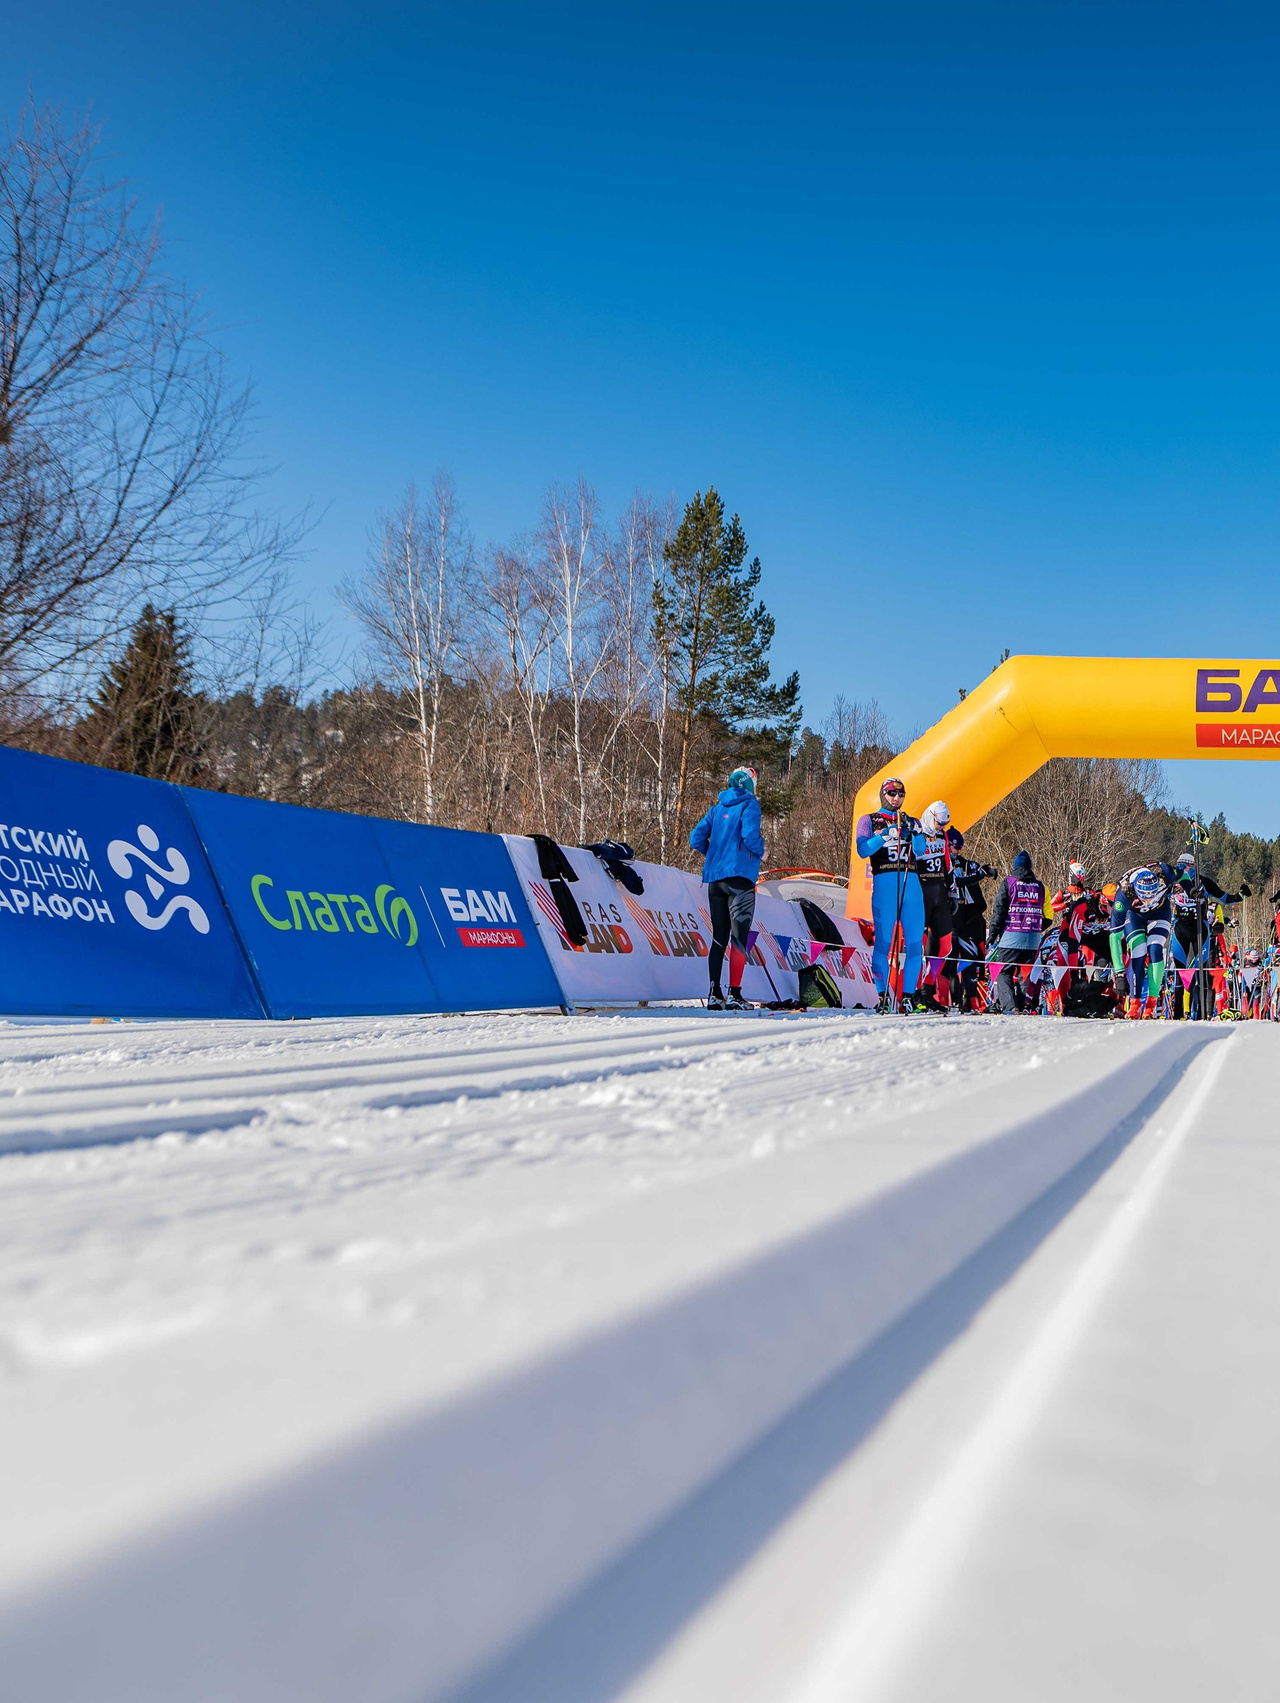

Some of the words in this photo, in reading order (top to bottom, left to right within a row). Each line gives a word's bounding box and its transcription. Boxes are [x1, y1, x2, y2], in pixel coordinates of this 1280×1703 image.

[0, 823, 90, 862] ТСКИЙ
[887, 846, 909, 863] 54
[925, 857, 942, 872] 39
[250, 873, 380, 934] Слата
[440, 887, 518, 924] БАМ
[1017, 891, 1039, 899] БАМ
[582, 901, 623, 923] RAS
[654, 910, 699, 930] KRAS
[468, 931, 517, 945] МАРАФОНЫ
[586, 923, 634, 954] LAND
[663, 930, 709, 957] LAND
